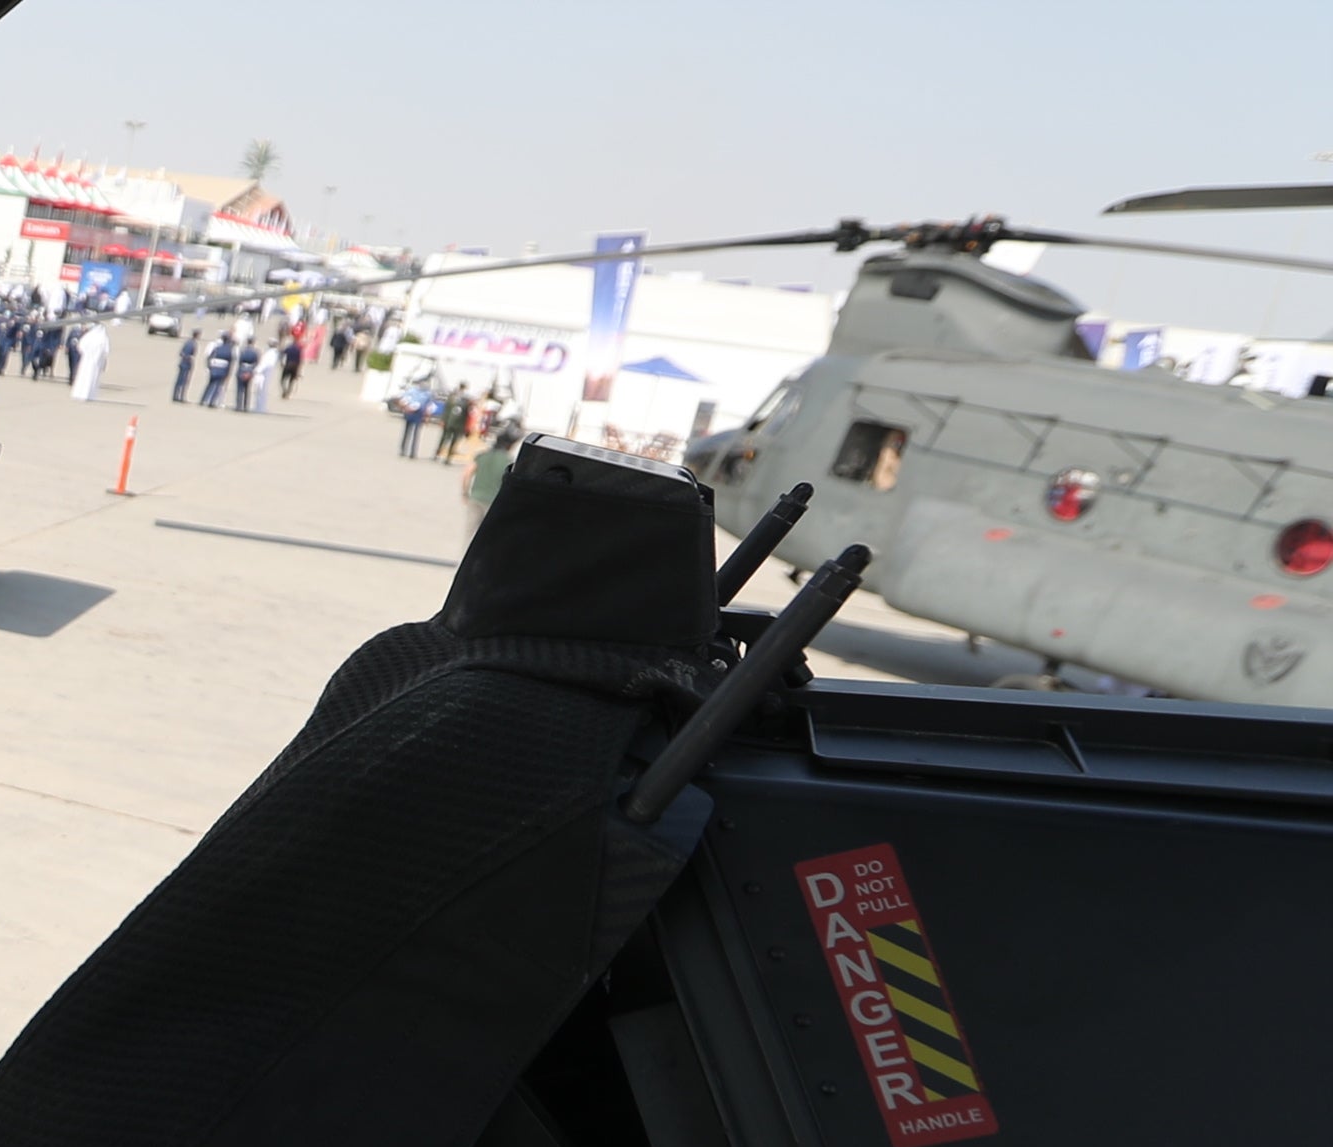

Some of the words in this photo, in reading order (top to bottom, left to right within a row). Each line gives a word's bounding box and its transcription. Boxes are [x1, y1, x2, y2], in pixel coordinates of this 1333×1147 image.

[853, 860, 883, 877] DO
[854, 876, 895, 896] NOT
[856, 895, 909, 915] PULL
[805, 872, 924, 1110] DANGER
[899, 1108, 983, 1135] HANDLE
